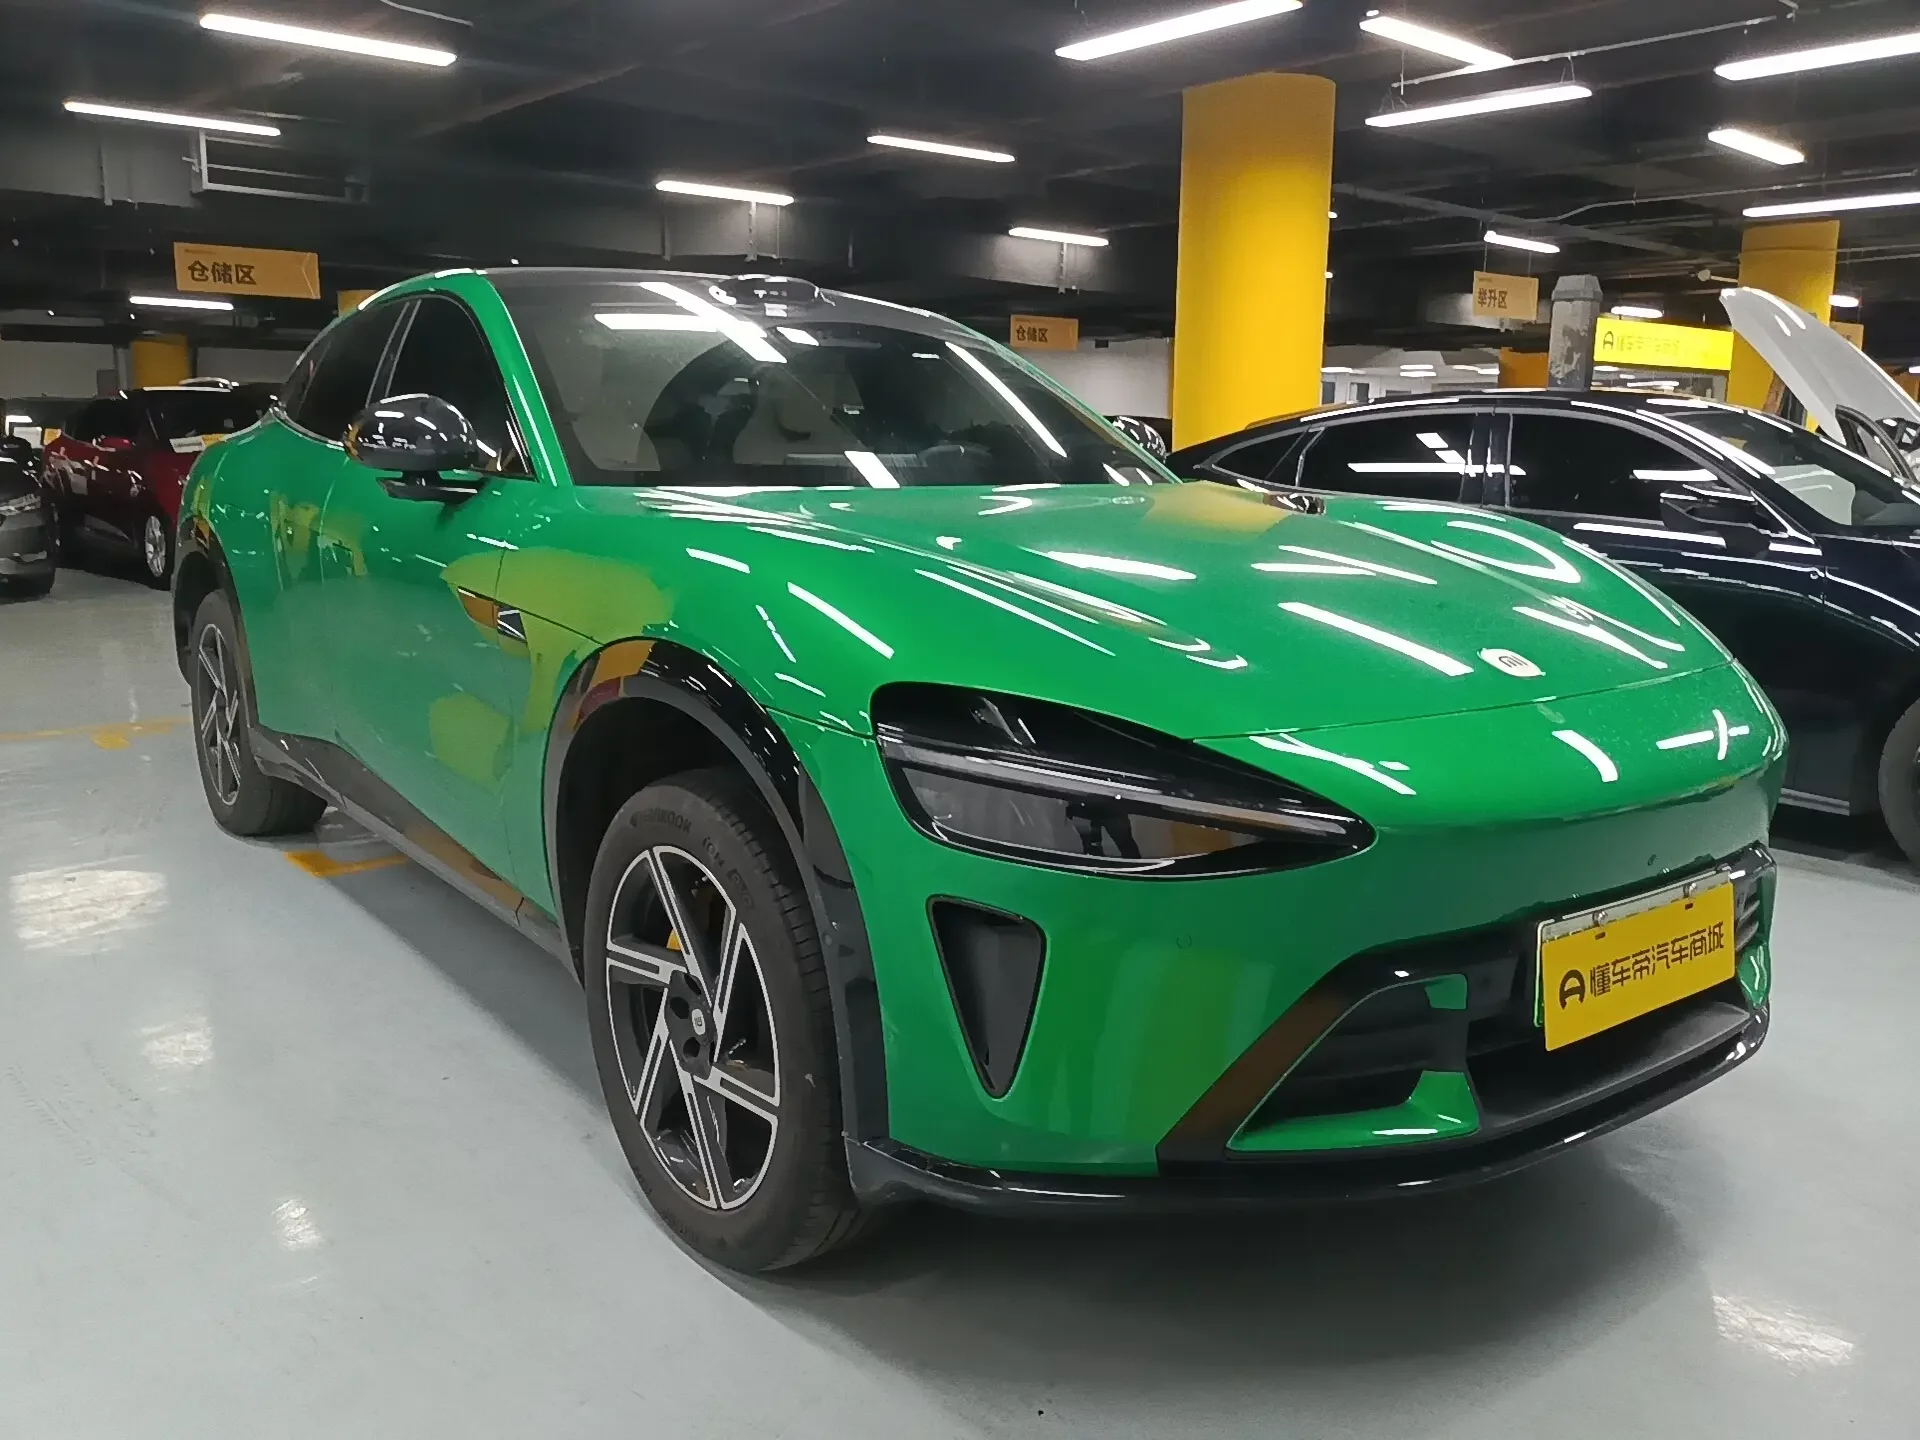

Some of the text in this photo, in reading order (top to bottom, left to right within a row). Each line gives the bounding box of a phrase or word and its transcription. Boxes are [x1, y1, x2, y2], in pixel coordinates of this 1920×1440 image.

[188, 260, 257, 285] 仓储区
[1016, 325, 1049, 342] 仓储区
[1589, 920, 1725, 998] 懂车帝汽车商城
